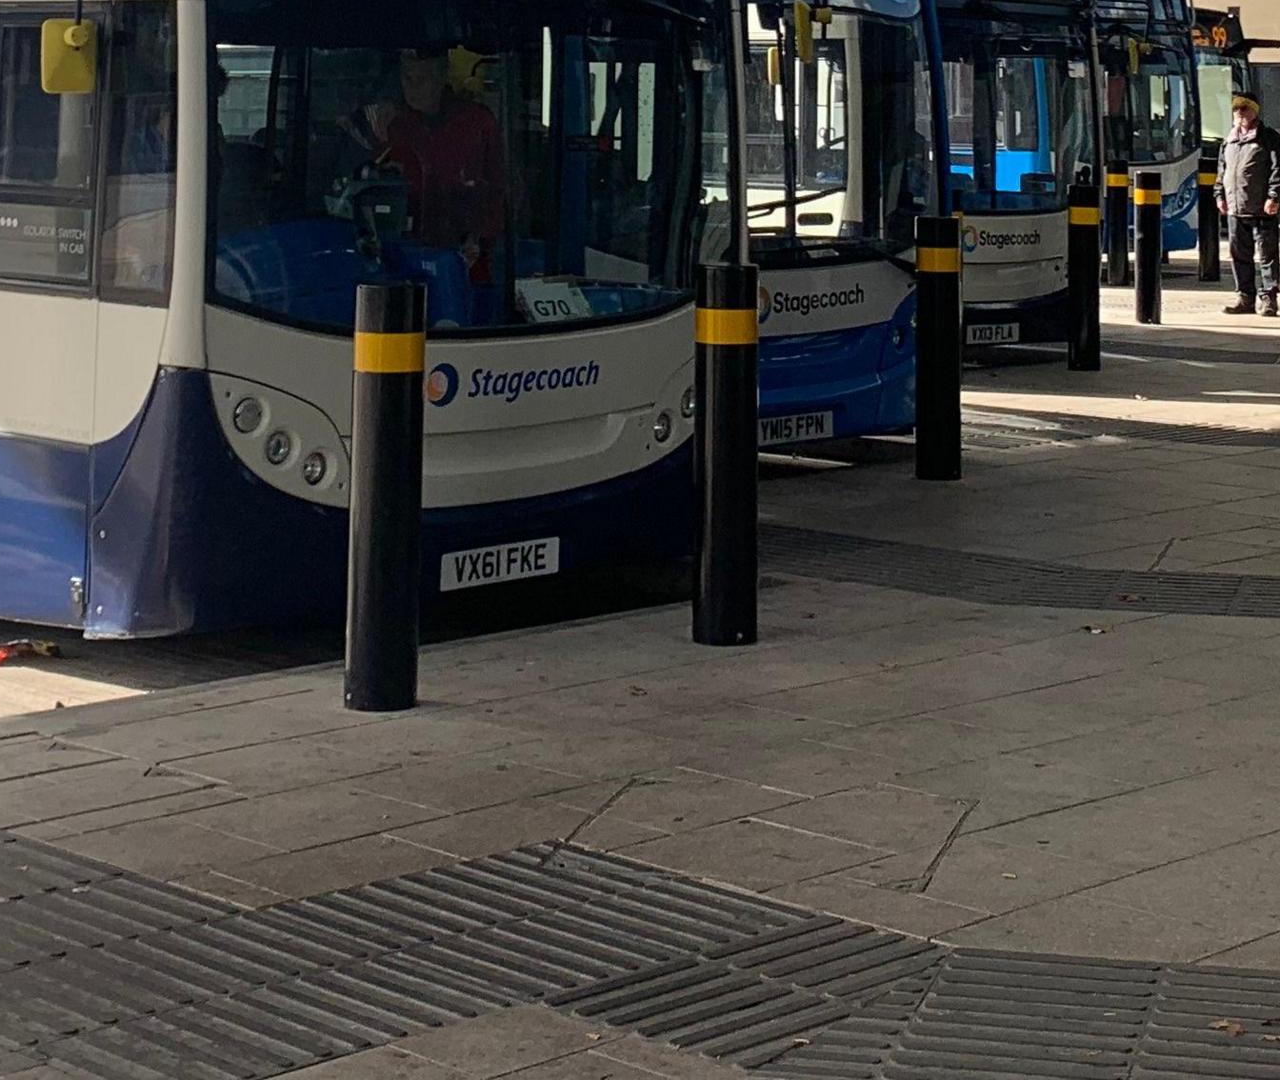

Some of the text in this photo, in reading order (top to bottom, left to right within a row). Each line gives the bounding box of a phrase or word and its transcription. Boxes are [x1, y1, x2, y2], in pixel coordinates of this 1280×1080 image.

[1211, 25, 1227, 48] 99
[68, 242, 85, 255] CAB
[978, 229, 1041, 249] Stagecoach
[533, 299, 571, 317] G70
[773, 283, 865, 315] Stagecoach
[468, 359, 601, 403] Stagecoach
[795, 414, 825, 437] FPN
[454, 542, 548, 583] VX61 FKE
